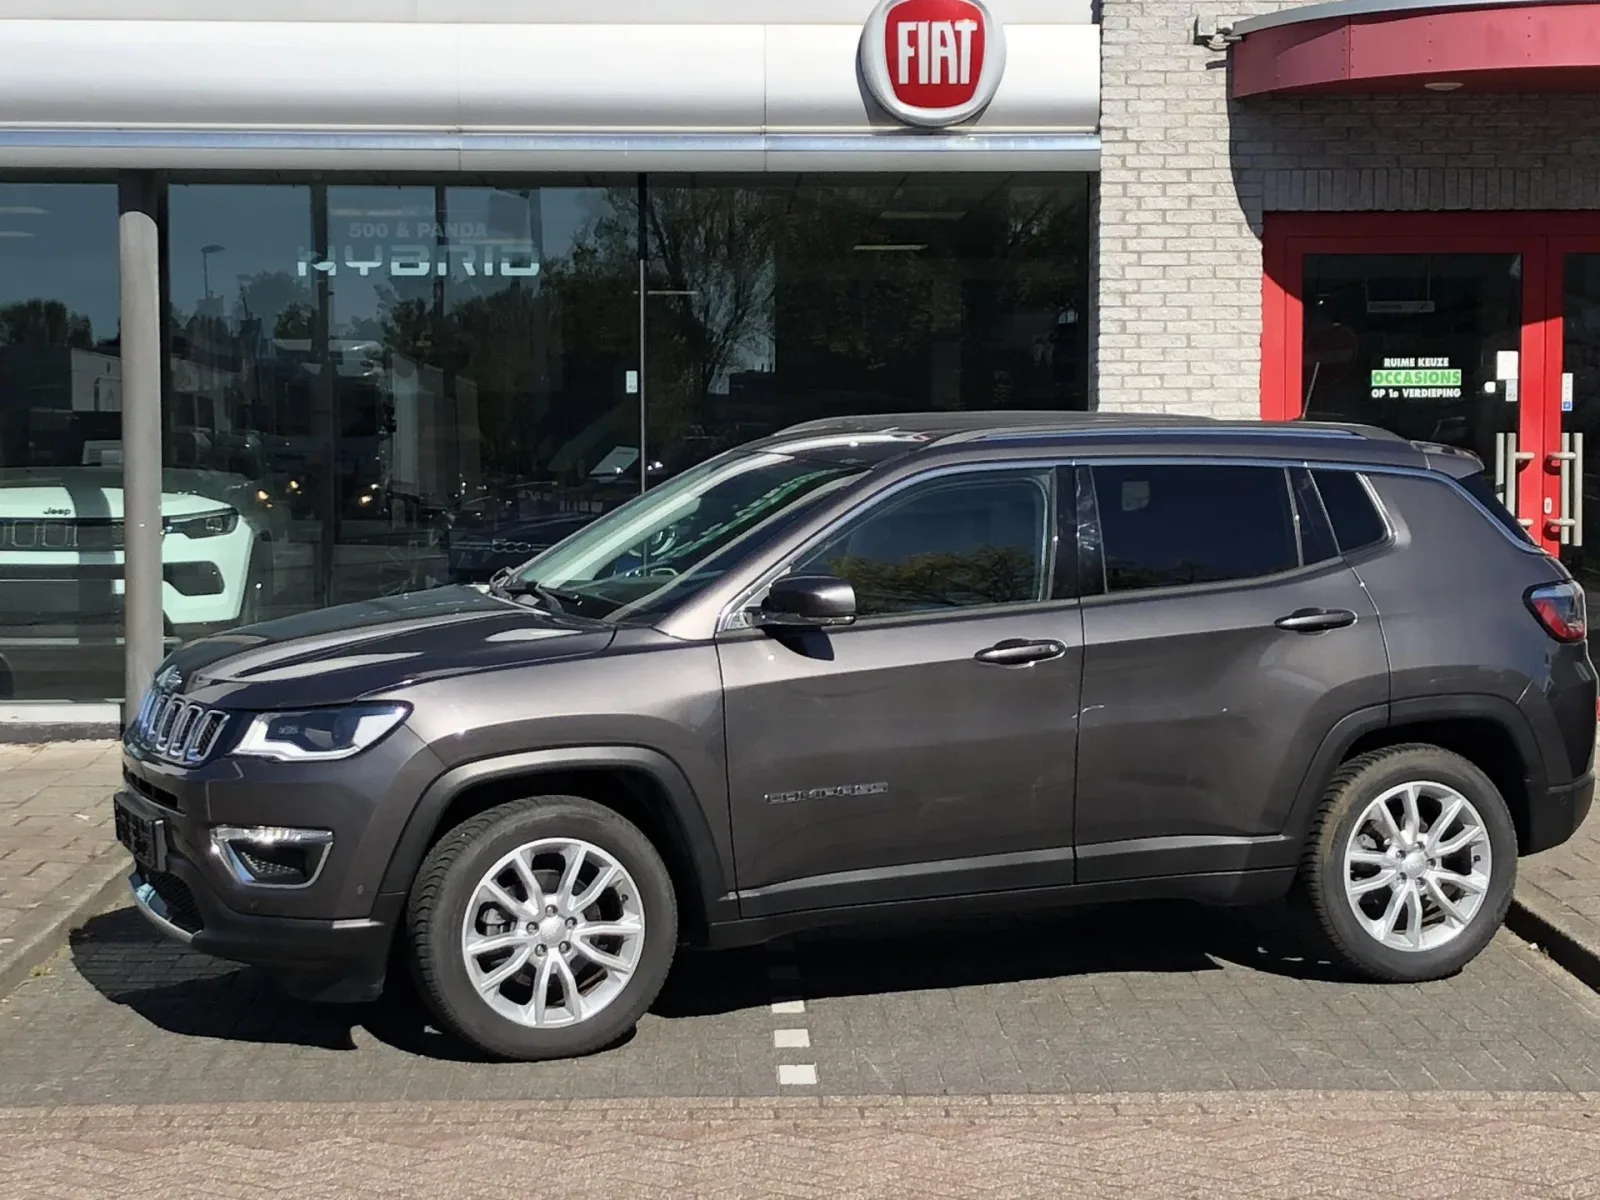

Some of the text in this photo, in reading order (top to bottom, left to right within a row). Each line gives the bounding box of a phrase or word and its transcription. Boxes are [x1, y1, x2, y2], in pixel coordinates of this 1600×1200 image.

[897, 20, 978, 85] FIAT
[349, 222, 489, 239] 500 & PANDA
[297, 245, 541, 277] HYBRID
[1383, 357, 1450, 368] RUIME KEUZE
[1373, 371, 1461, 385] OCCASIONS
[1371, 388, 1387, 398] OP
[1402, 388, 1462, 398] VERDIEPING
[43, 506, 72, 517] Jeep
